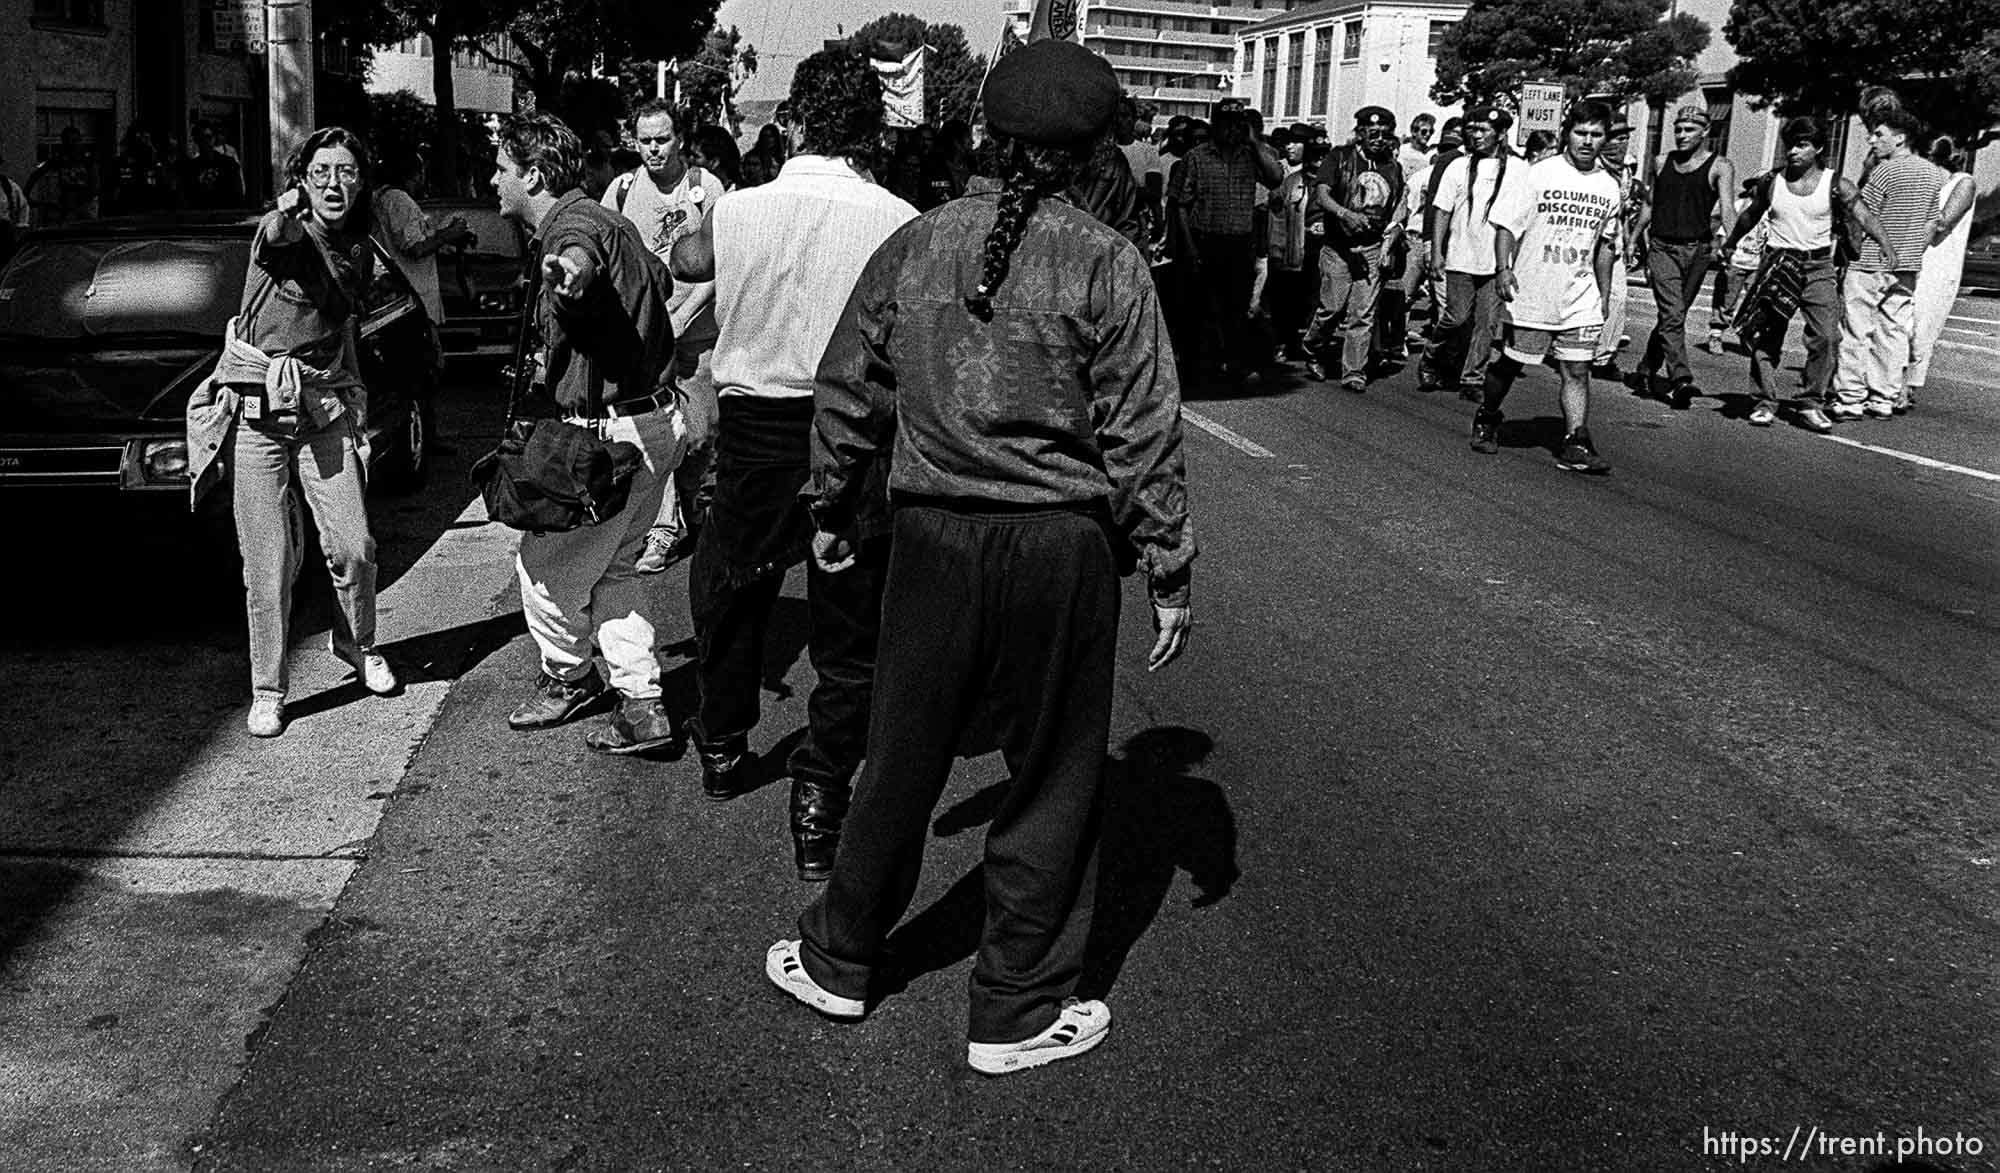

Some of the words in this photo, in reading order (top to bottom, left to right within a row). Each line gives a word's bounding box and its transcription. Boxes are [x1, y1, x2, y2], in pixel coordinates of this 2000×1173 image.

[1524, 89, 1541, 100] LEFT
[1543, 91, 1561, 102] LANE
[1527, 108, 1554, 121] MUST
[1543, 190, 1611, 209] COLUMBUS
